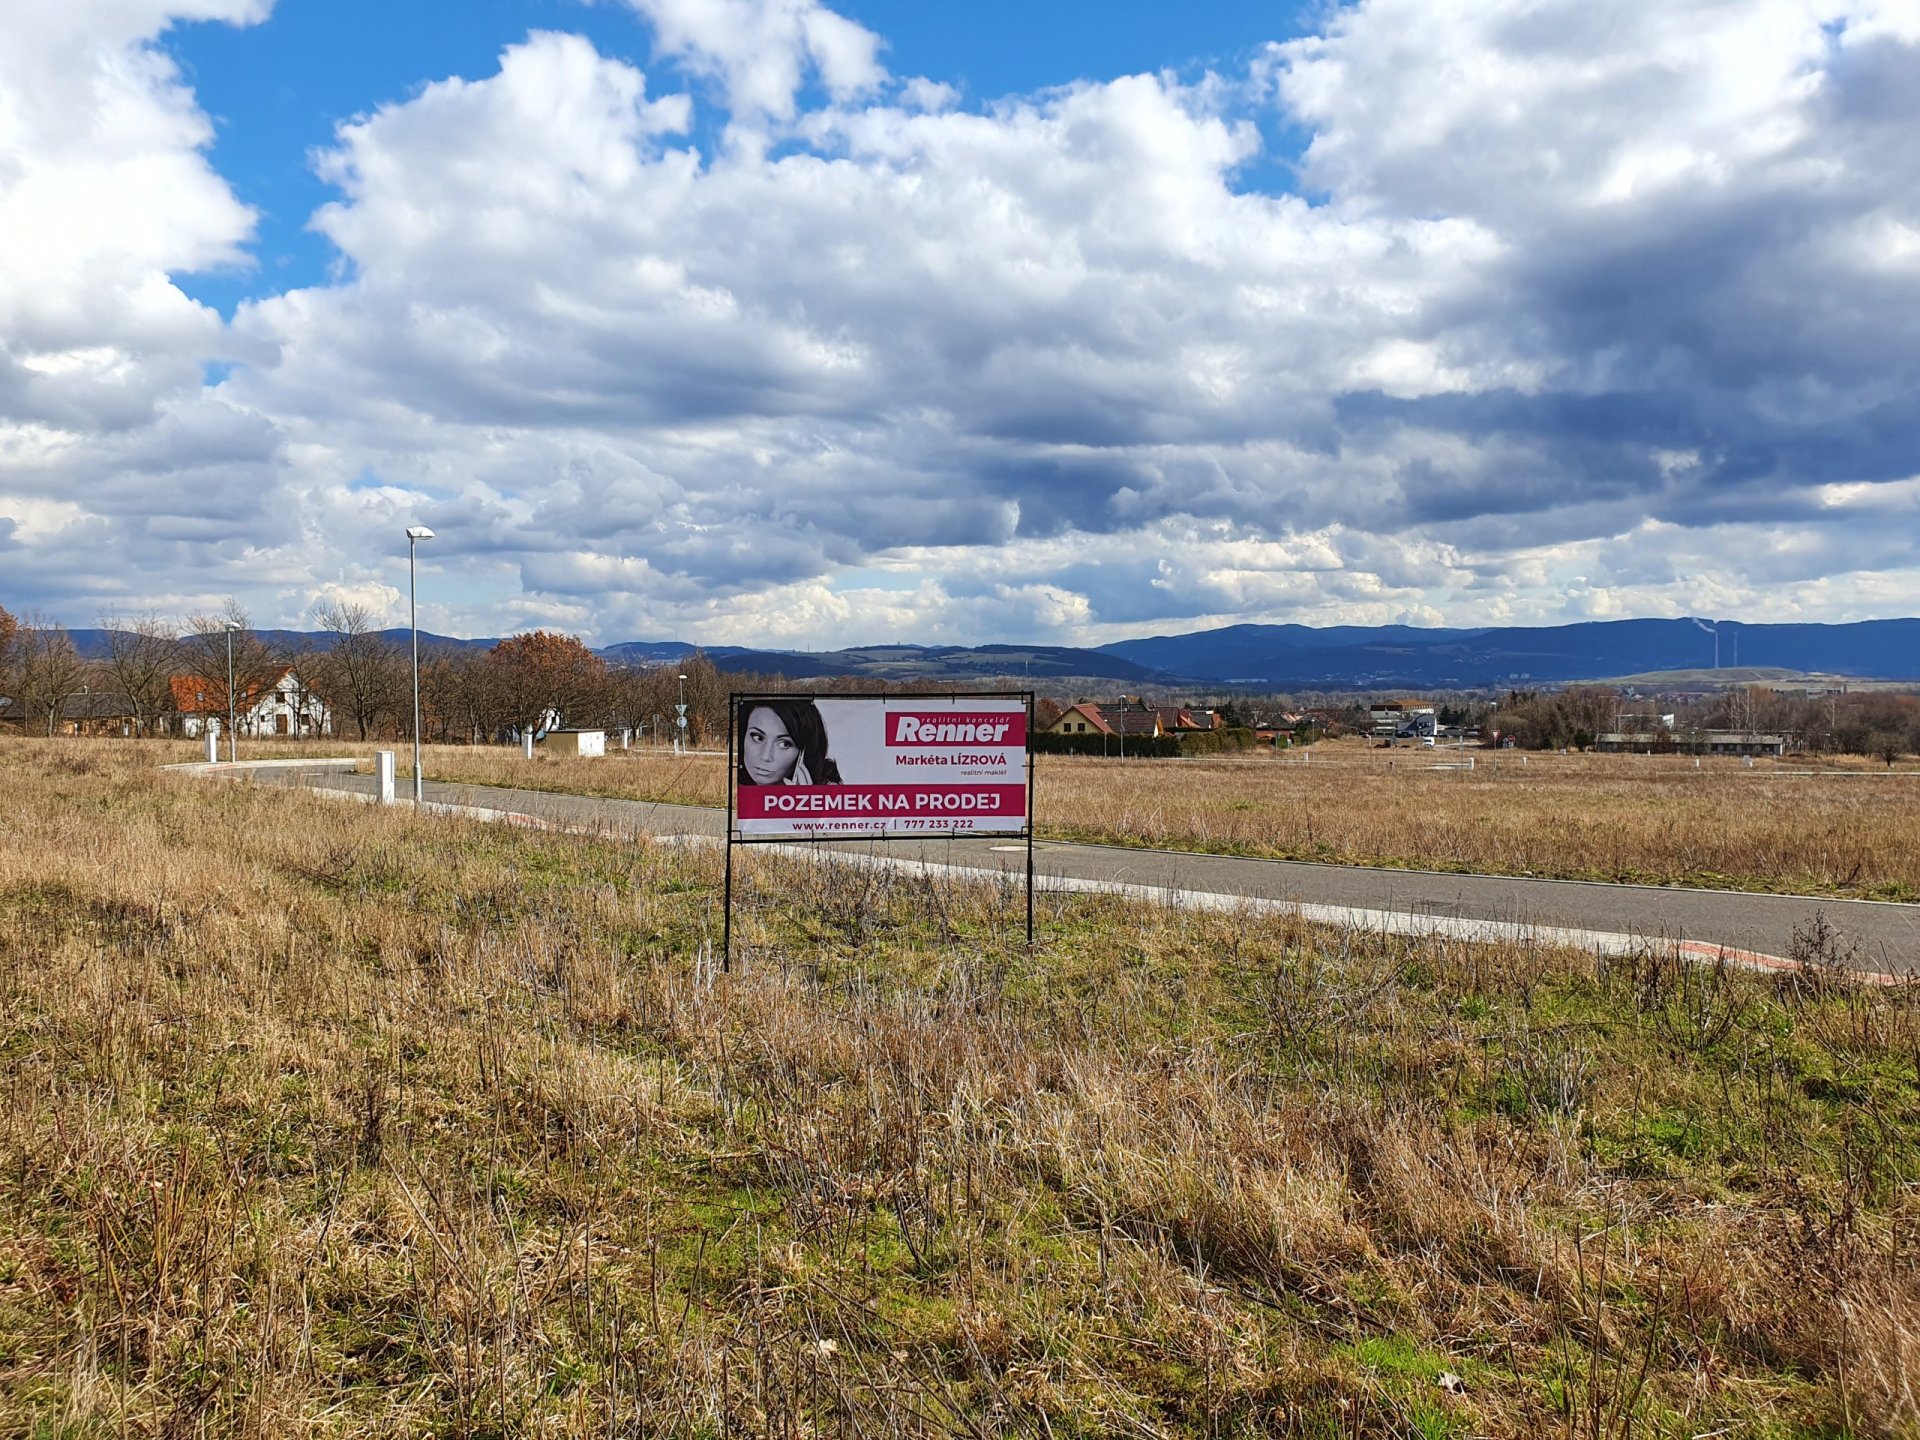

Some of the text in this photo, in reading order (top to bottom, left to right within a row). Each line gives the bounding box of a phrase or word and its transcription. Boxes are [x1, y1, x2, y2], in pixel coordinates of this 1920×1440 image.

[895, 716, 1009, 742] Renner
[896, 753, 1007, 765] Markéta LÍZROVÁ
[764, 793, 1000, 811] POZEMEK NA PRODEJ
[792, 819, 974, 830] www.renner.cz 777 233 222
